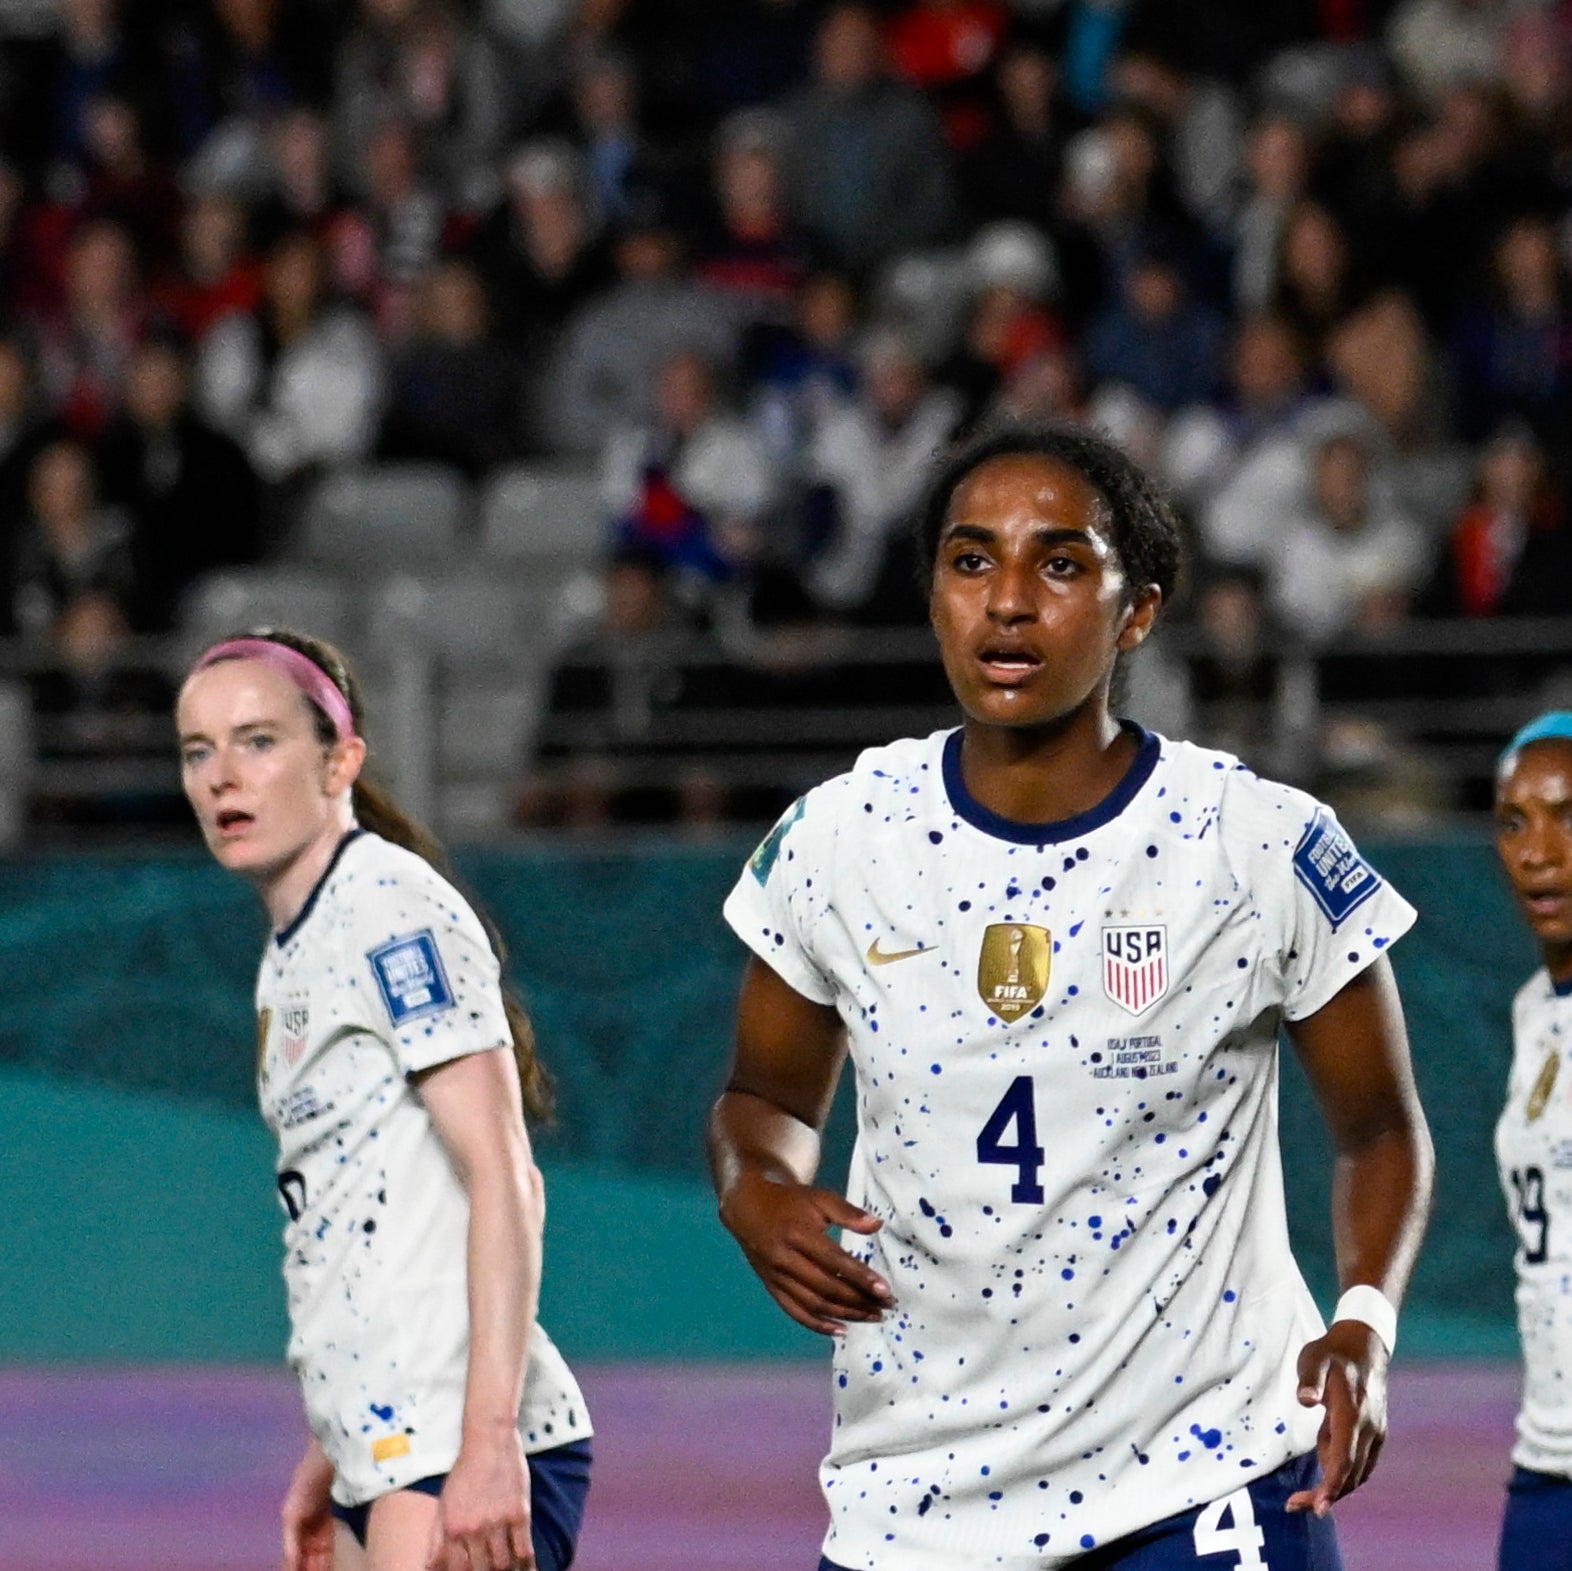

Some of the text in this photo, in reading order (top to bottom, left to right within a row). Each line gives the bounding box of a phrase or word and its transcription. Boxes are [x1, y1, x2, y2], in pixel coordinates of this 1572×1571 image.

[1306, 827, 1335, 865] FOOTB
[1107, 931, 1161, 964] USA
[994, 985, 1028, 999] FIFA
[976, 1075, 1045, 1205] 4
